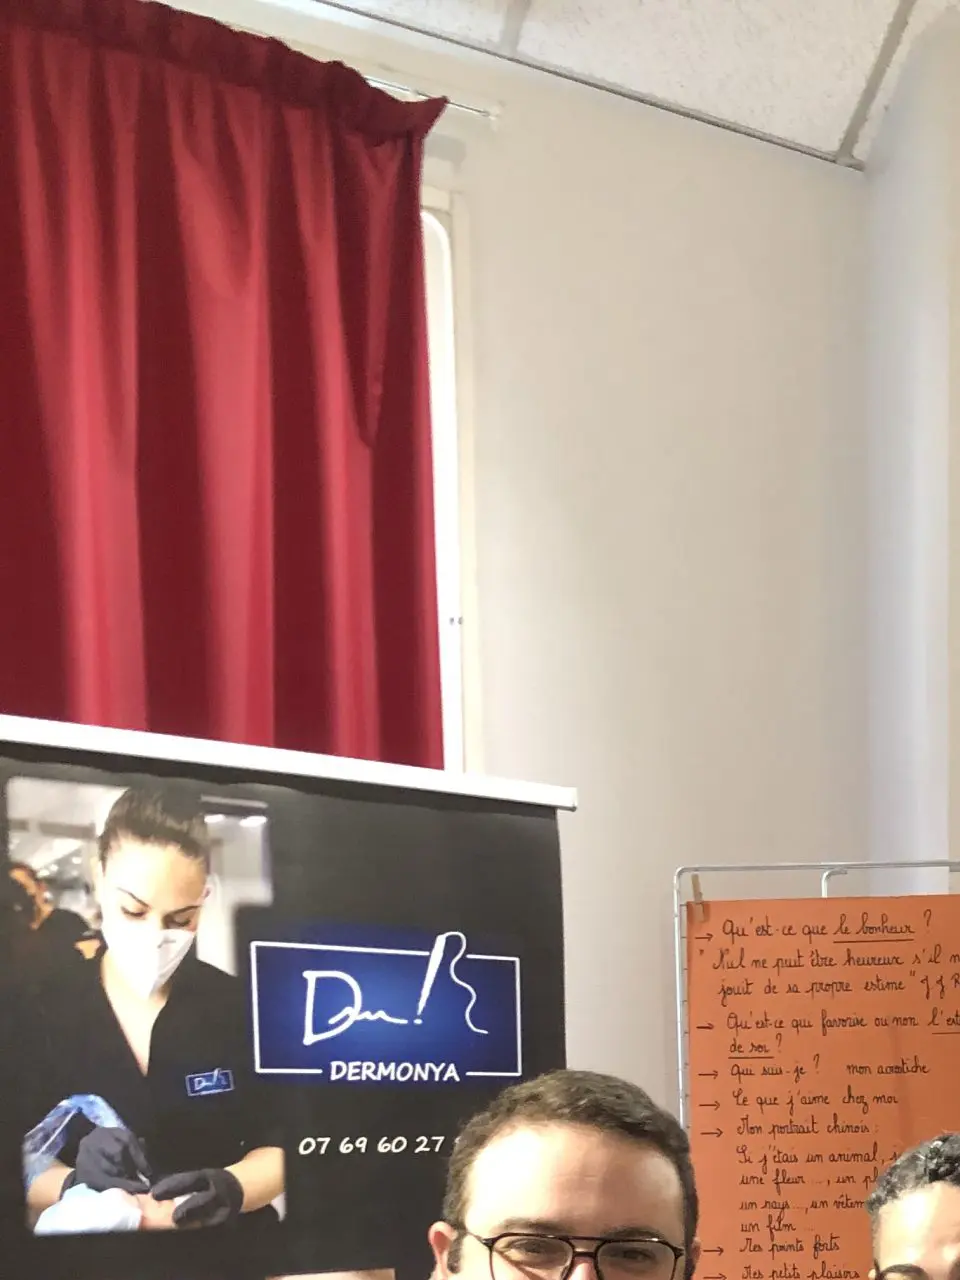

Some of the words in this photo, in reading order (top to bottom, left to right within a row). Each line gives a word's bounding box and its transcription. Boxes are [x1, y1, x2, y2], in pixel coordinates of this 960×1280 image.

[722, 914, 797, 945] Qu'est-ce
[801, 923, 828, 944] que
[833, 913, 850, 935] le
[856, 911, 915, 935] bonheur
[923, 908, 932, 934] ?
[712, 947, 746, 970] Nul
[751, 958, 768, 969] ne
[772, 948, 805, 976] peut
[810, 948, 837, 967] être
[843, 948, 904, 966] heureux
[911, 943, 941, 965] s'il
[718, 978, 754, 1007] jouit
[763, 978, 779, 995] de
[785, 983, 801, 994] sa
[805, 981, 853, 1000] propre
[726, 1010, 785, 1037] Qu'est-ce
[790, 1018, 814, 1035] qui
[821, 1008, 868, 1037] favorise
[874, 1016, 889, 1027] ou
[892, 1015, 919, 1027] non
[729, 1037, 745, 1054] de
[748, 1041, 770, 1053] soi
[775, 1032, 783, 1053] ?
[330, 1060, 461, 1082] DERMONYA
[730, 1062, 756, 1085] Qui
[813, 1053, 821, 1074] ?
[846, 1063, 872, 1075] mon
[876, 1055, 931, 1075] acrostiche
[755, 1095, 781, 1114] que
[786, 1089, 831, 1116] j'aime
[842, 1084, 870, 1114] chez
[872, 1094, 900, 1105] moi
[736, 1114, 763, 1136] Mon
[768, 1115, 820, 1140] portrait
[826, 1113, 871, 1134] chinois
[299, 1137, 331, 1154] 07
[339, 1137, 367, 1154] 69
[377, 1137, 407, 1153] 60
[414, 1135, 445, 1153] 27
[736, 1144, 753, 1164] Si
[758, 1144, 799, 1175] j'étais
[805, 1152, 824, 1163] un
[828, 1141, 885, 1165] animal,
[738, 1174, 765, 1185] une
[772, 1168, 806, 1196] fleur
[835, 1174, 856, 1184] un
[739, 1200, 758, 1210] un
[810, 1200, 829, 1209] un
[833, 1194, 865, 1210] vêtem
[740, 1222, 760, 1233] un
[766, 1213, 797, 1242] film
[739, 1238, 764, 1254] Mes
[768, 1239, 805, 1260] points
[813, 1233, 841, 1258] forts
[741, 1265, 765, 1280] Mes
